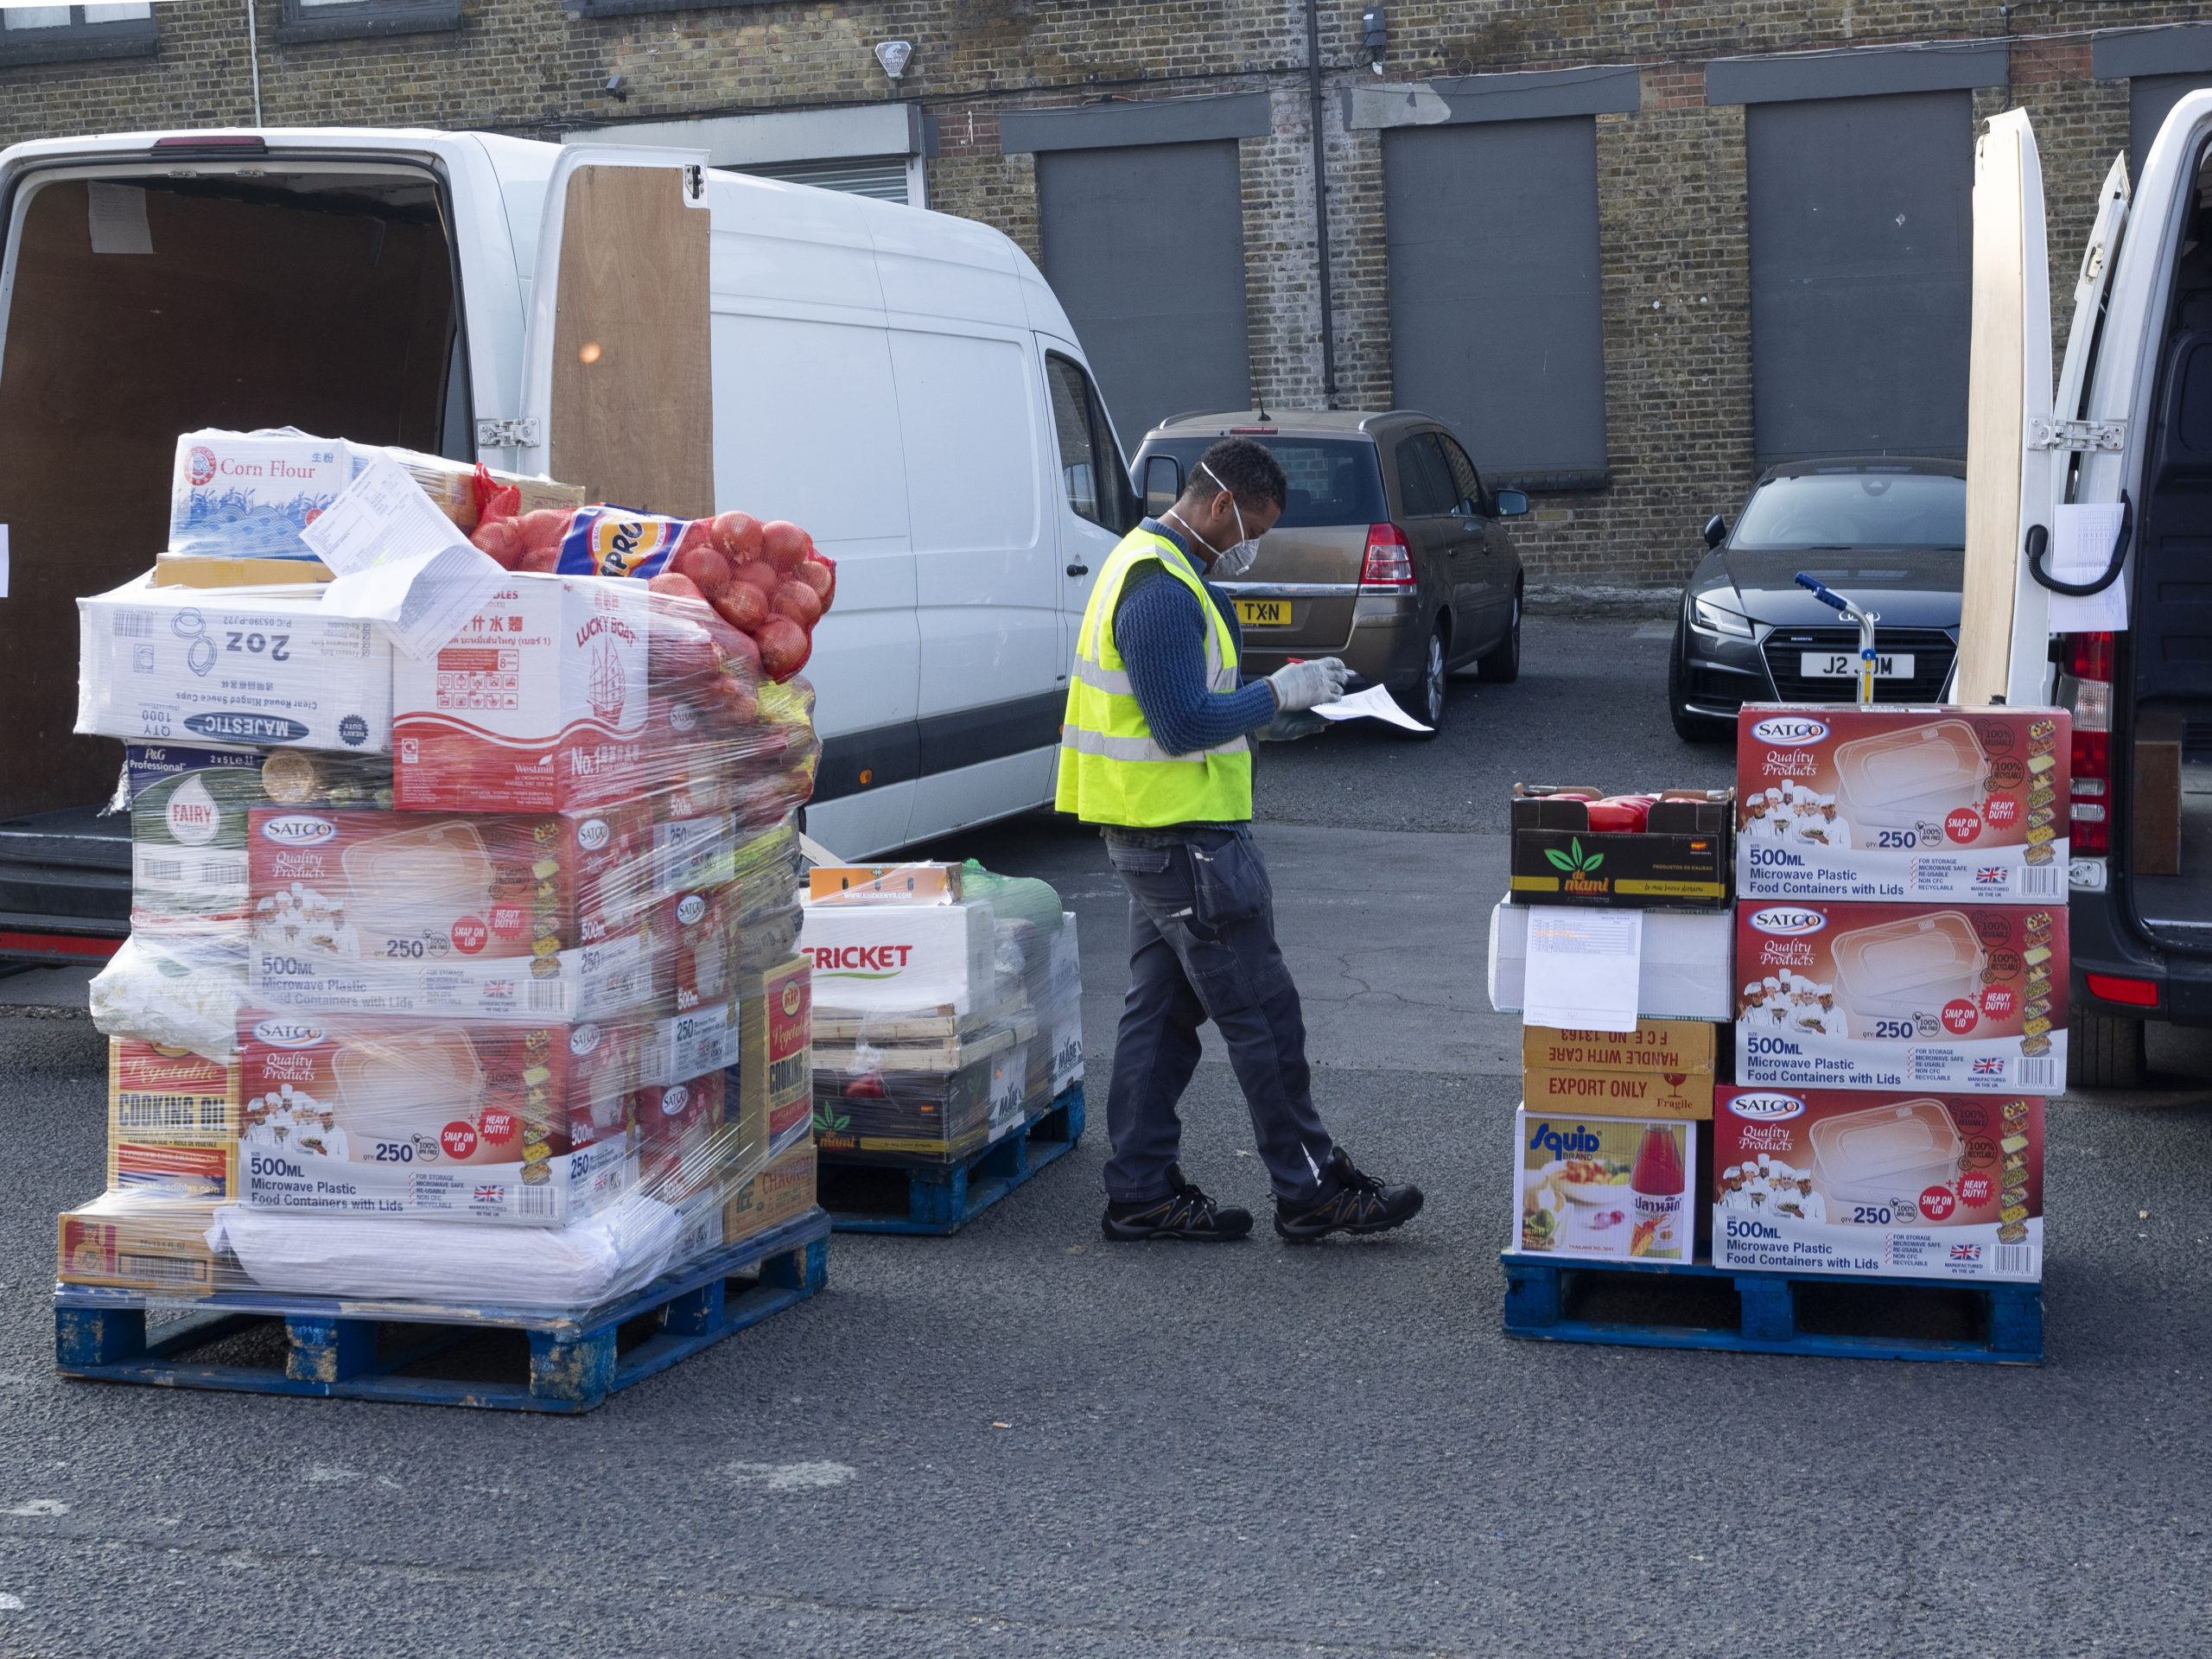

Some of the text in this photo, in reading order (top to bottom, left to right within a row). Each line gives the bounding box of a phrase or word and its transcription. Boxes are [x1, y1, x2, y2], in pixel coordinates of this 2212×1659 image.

[312, 452, 334, 463] 生粉
[221, 459, 263, 476] Corn
[270, 460, 315, 479] Flour
[1244, 603, 1280, 620] TXN
[576, 615, 636, 648] LUCKY BOAT
[1823, 656, 1847, 674] J2
[175, 691, 318, 710] Clear Round Hinged Sauce Cups
[142, 709, 171, 722] 1000
[143, 724, 171, 737] QTY
[205, 715, 289, 737] MAJESTIC
[1759, 724, 1824, 736] SATCO
[145, 748, 166, 760] P&G
[211, 755, 216, 764] 2
[571, 747, 601, 775] No.1
[1767, 748, 1815, 766] Quality
[130, 760, 183, 772] Professional
[514, 764, 554, 773] Westmill
[1763, 763, 1817, 776] Products
[173, 804, 212, 823] FAIRY
[1990, 802, 2014, 810] HEAVY
[1988, 810, 2014, 820] DUTY!!
[268, 823, 332, 836] SATCO
[1948, 818, 1978, 828] SNAP ON
[580, 826, 607, 841] SATCO
[671, 827, 687, 847] 250
[1878, 831, 1916, 849] 250
[1958, 828, 1969, 837] LID
[276, 849, 323, 868] Quality
[1750, 849, 1805, 866] 500ML
[272, 864, 326, 879] Products
[1573, 869, 1586, 880] de
[1750, 868, 1858, 880] Microwave Plastic
[1750, 882, 1904, 895] Food Containers with Lids
[678, 902, 704, 918] SATCO
[1757, 913, 1821, 926] SATCO
[386, 940, 423, 957] 250
[1764, 938, 1811, 956] Quality
[261, 957, 316, 976] 500ML
[582, 951, 600, 975] 250
[1760, 952, 1814, 966] Products
[262, 977, 367, 993] Microwave Plastic
[295, 993, 414, 1009] Containers with Lids
[1986, 993, 2011, 1001] HEAVY
[1985, 1001, 2011, 1010] DUTY!!
[1945, 1009, 1975, 1019] SNAP ON
[677, 1019, 694, 1042] 250
[1875, 1021, 1913, 1039] 250
[1955, 1019, 1967, 1027] LID
[259, 1024, 322, 1039] SATCO
[571, 1031, 601, 1047] SATCO
[1560, 1029, 1600, 1042] 13163
[1747, 1038, 1803, 1054] 500ML
[266, 1052, 313, 1071] Quality
[1548, 1046, 1679, 1066] HANDLE WITH CARE
[1747, 1057, 1854, 1070] Microwave Plastic
[126, 1058, 218, 1084] Vegetable
[262, 1066, 315, 1081] Products
[770, 1052, 803, 1096] COOKING
[1747, 1070, 1901, 1084] Food Containers with Lids
[1549, 1077, 1648, 1099] EXPORT ONLY
[663, 1090, 689, 1106] SATCO
[1656, 1098, 1693, 1110] Fragile
[1735, 1099, 1800, 1112] SATCO
[119, 1094, 227, 1131] COOKING OIL
[486, 1116, 511, 1125] HEAVY
[444, 1132, 474, 1142] SNAP ON
[484, 1125, 510, 1135] DUTY!!
[1743, 1123, 1789, 1142] Quality
[454, 1142, 466, 1152] LID
[1738, 1138, 1793, 1151] Products
[376, 1143, 413, 1162] 250
[1563, 1153, 1593, 1161] BRAND
[251, 1158, 305, 1177] 500ML
[570, 1154, 589, 1179] 250
[251, 1179, 357, 1194] Microwave Plastic
[251, 1192, 404, 1211] Food Containers with Lids
[1853, 1206, 1891, 1224] 250
[1726, 1221, 1781, 1238] 500ML
[1726, 1240, 1833, 1254] Microwave Plastic
[1726, 1253, 1878, 1269] Food Containers with Lids
